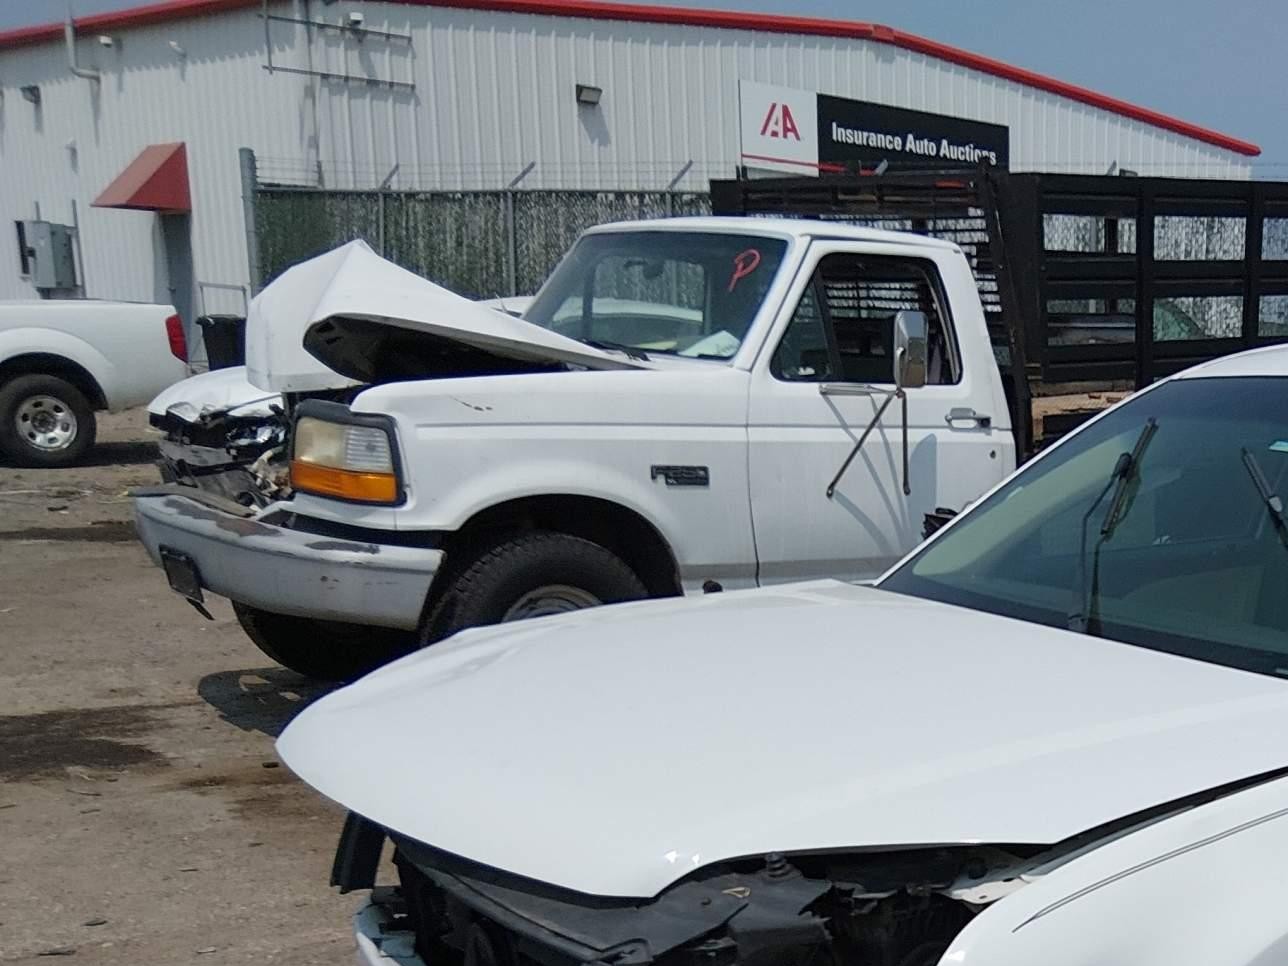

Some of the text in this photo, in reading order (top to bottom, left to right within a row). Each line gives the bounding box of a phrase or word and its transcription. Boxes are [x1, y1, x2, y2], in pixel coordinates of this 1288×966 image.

[831, 121, 902, 152] Insurance
[905, 133, 937, 157] Auto
[729, 249, 761, 292] P
